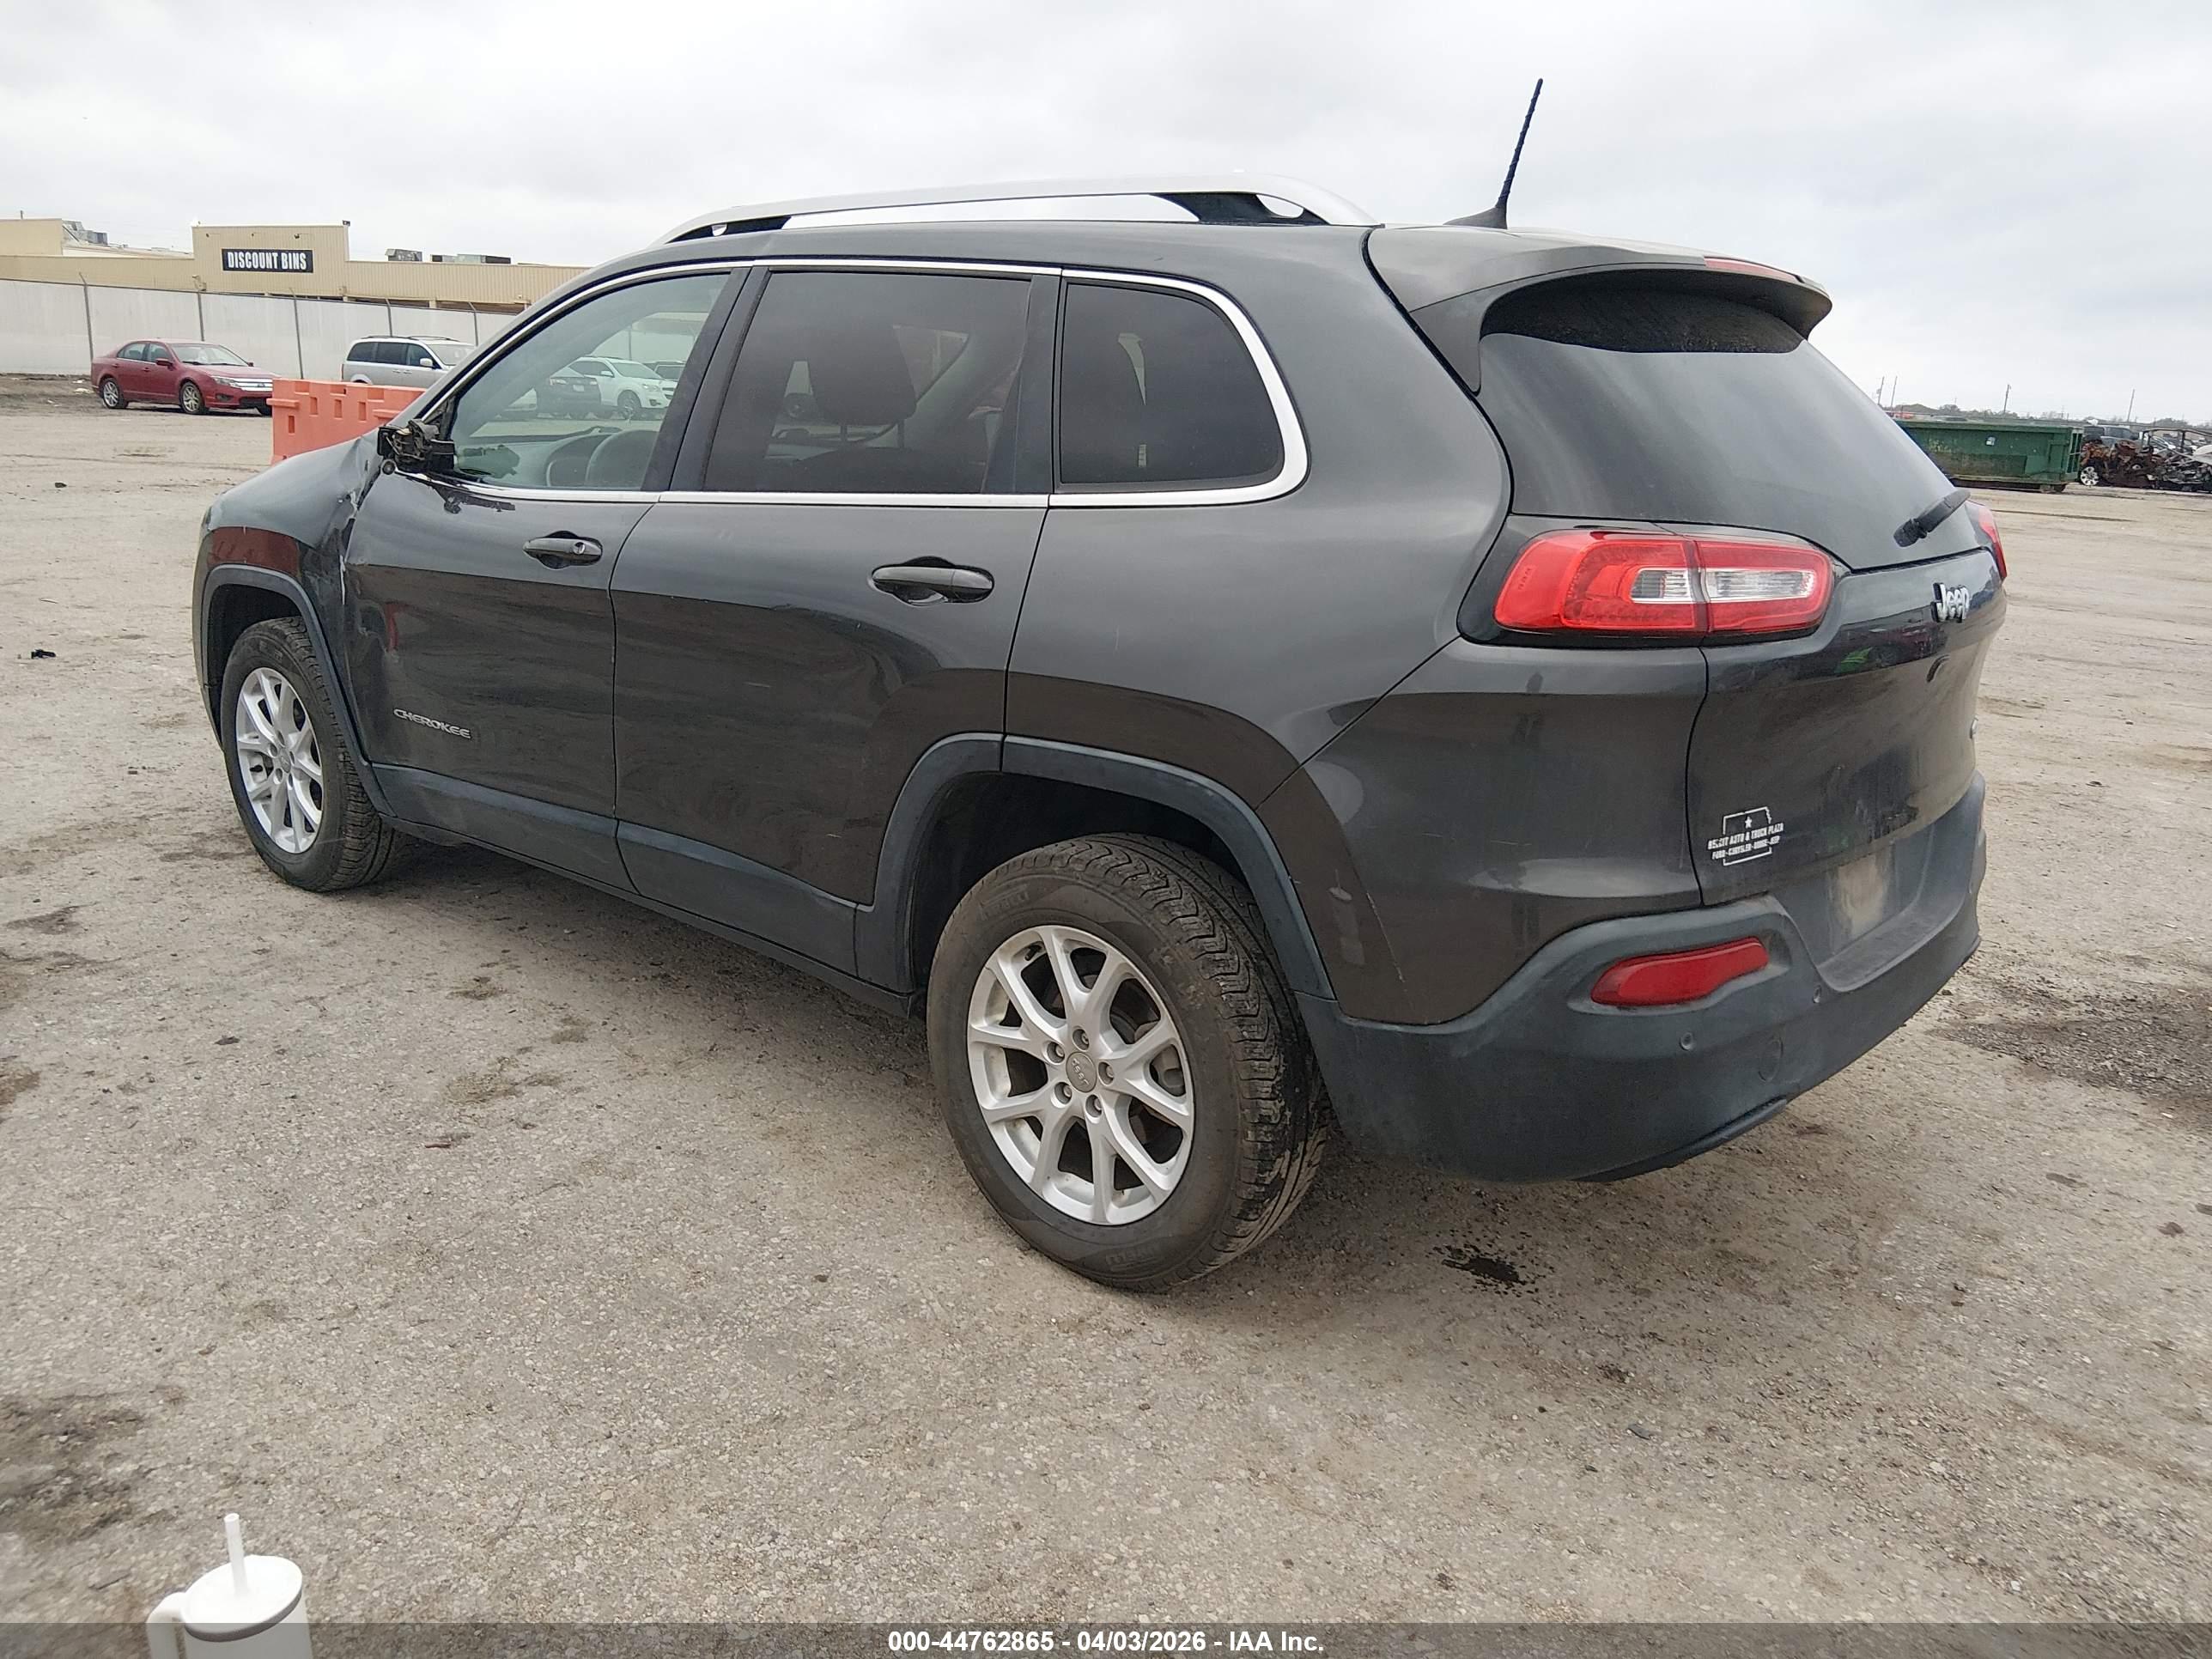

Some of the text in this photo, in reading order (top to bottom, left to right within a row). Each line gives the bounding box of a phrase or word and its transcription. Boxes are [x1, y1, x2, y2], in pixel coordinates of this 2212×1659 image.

[227, 251, 307, 270] DISCOUNT BINS
[1932, 582, 1970, 621] Jeep
[393, 708, 471, 739] CHEROKEE
